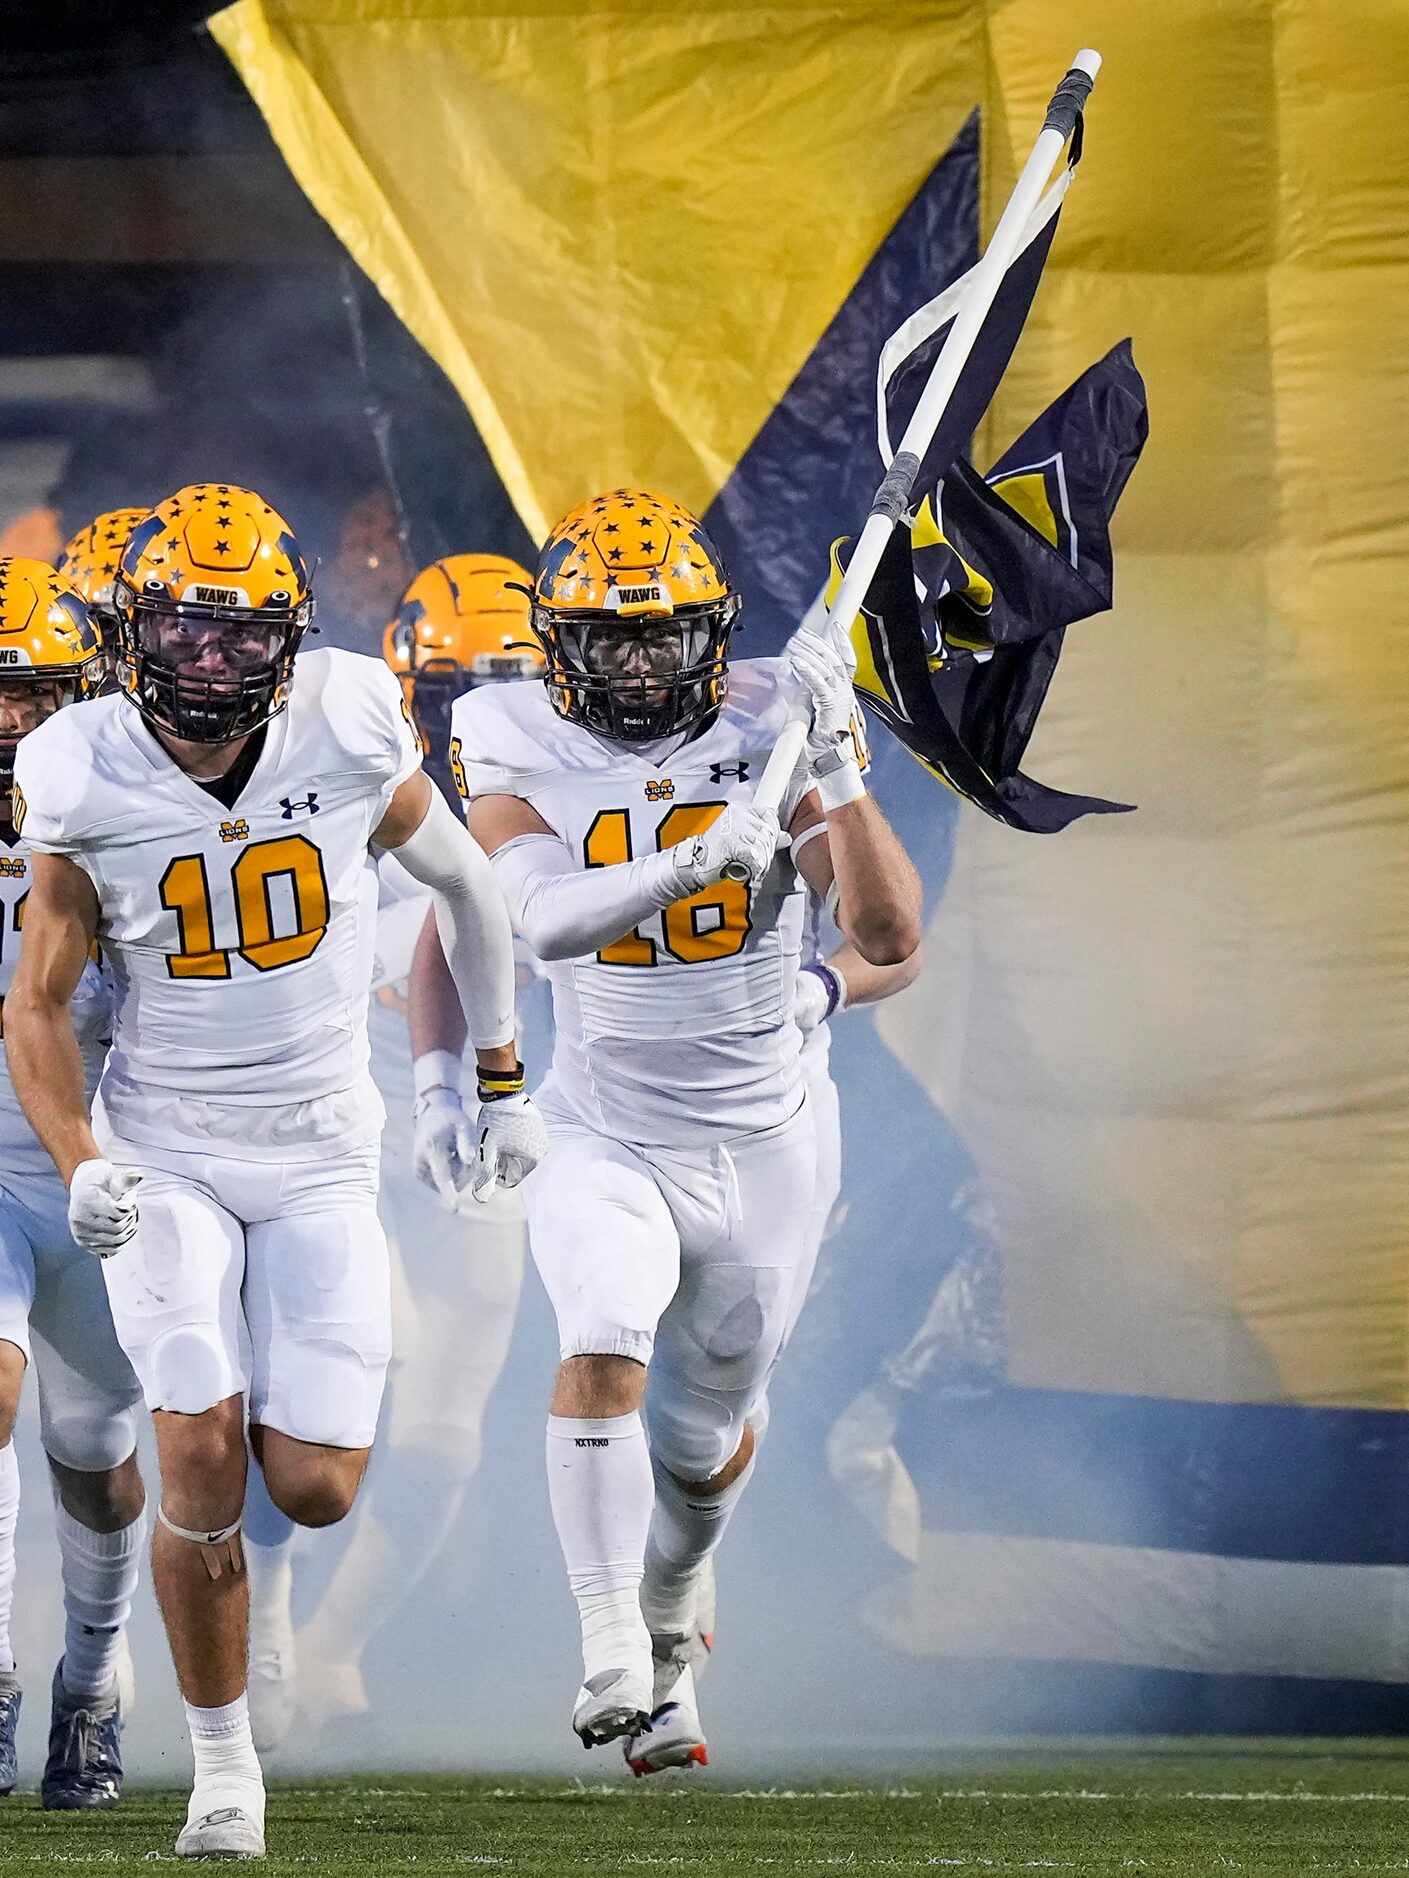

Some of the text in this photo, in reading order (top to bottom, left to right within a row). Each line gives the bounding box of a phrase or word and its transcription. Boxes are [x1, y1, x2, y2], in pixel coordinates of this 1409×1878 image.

[195, 586, 239, 605] WAWG
[618, 587, 660, 604] WAWG
[645, 784, 675, 796] LIONS
[219, 825, 250, 837] LIONS
[158, 834, 331, 979] 10
